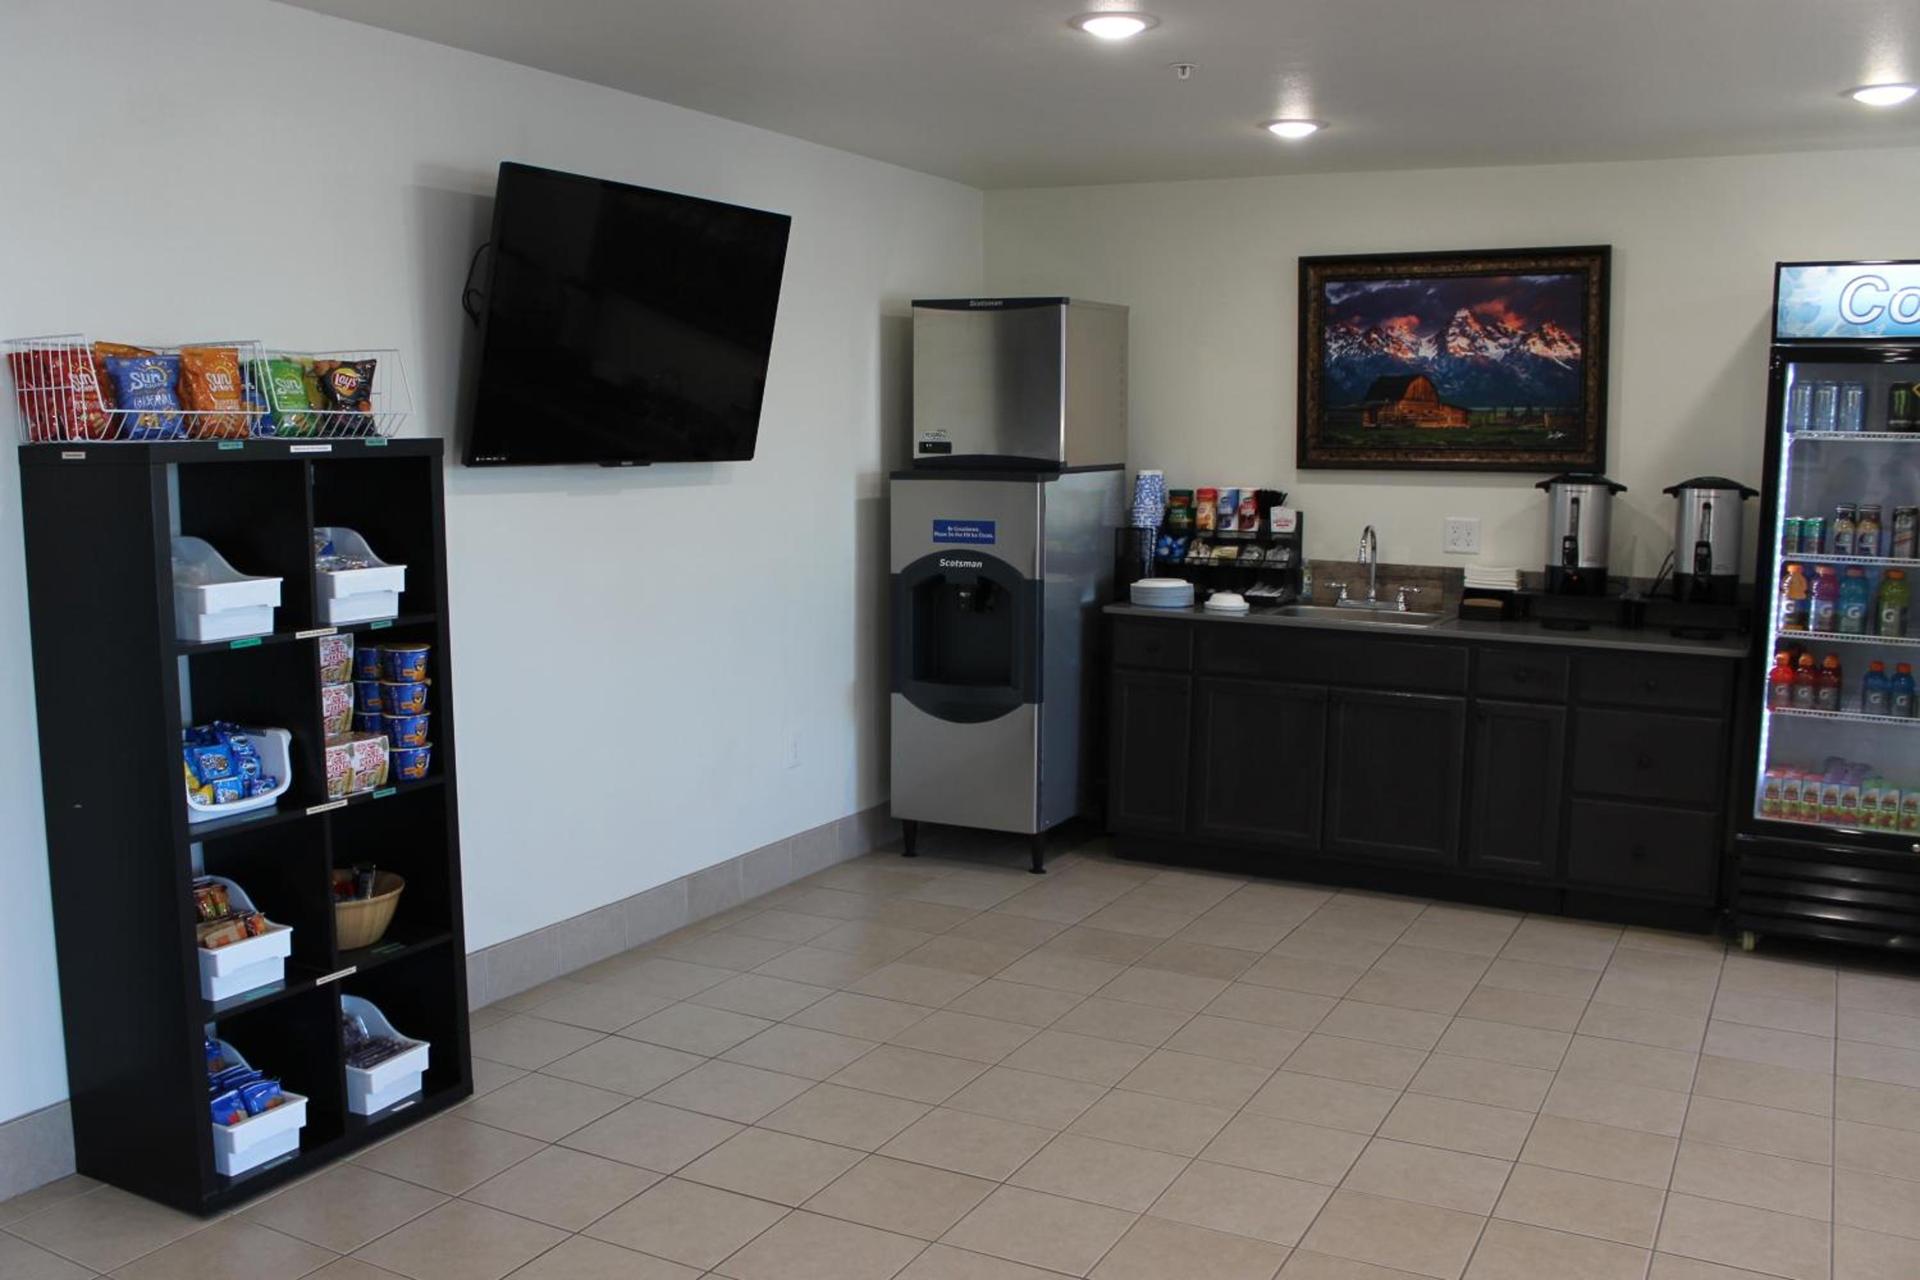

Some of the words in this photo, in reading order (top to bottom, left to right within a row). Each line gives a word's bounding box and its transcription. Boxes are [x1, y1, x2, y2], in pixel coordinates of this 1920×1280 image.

[128, 372, 162, 392] Sun
[206, 372, 232, 391] Sun
[939, 558, 983, 568] Scotsman
[1848, 606, 1861, 619] G
[1882, 608, 1895, 623] G
